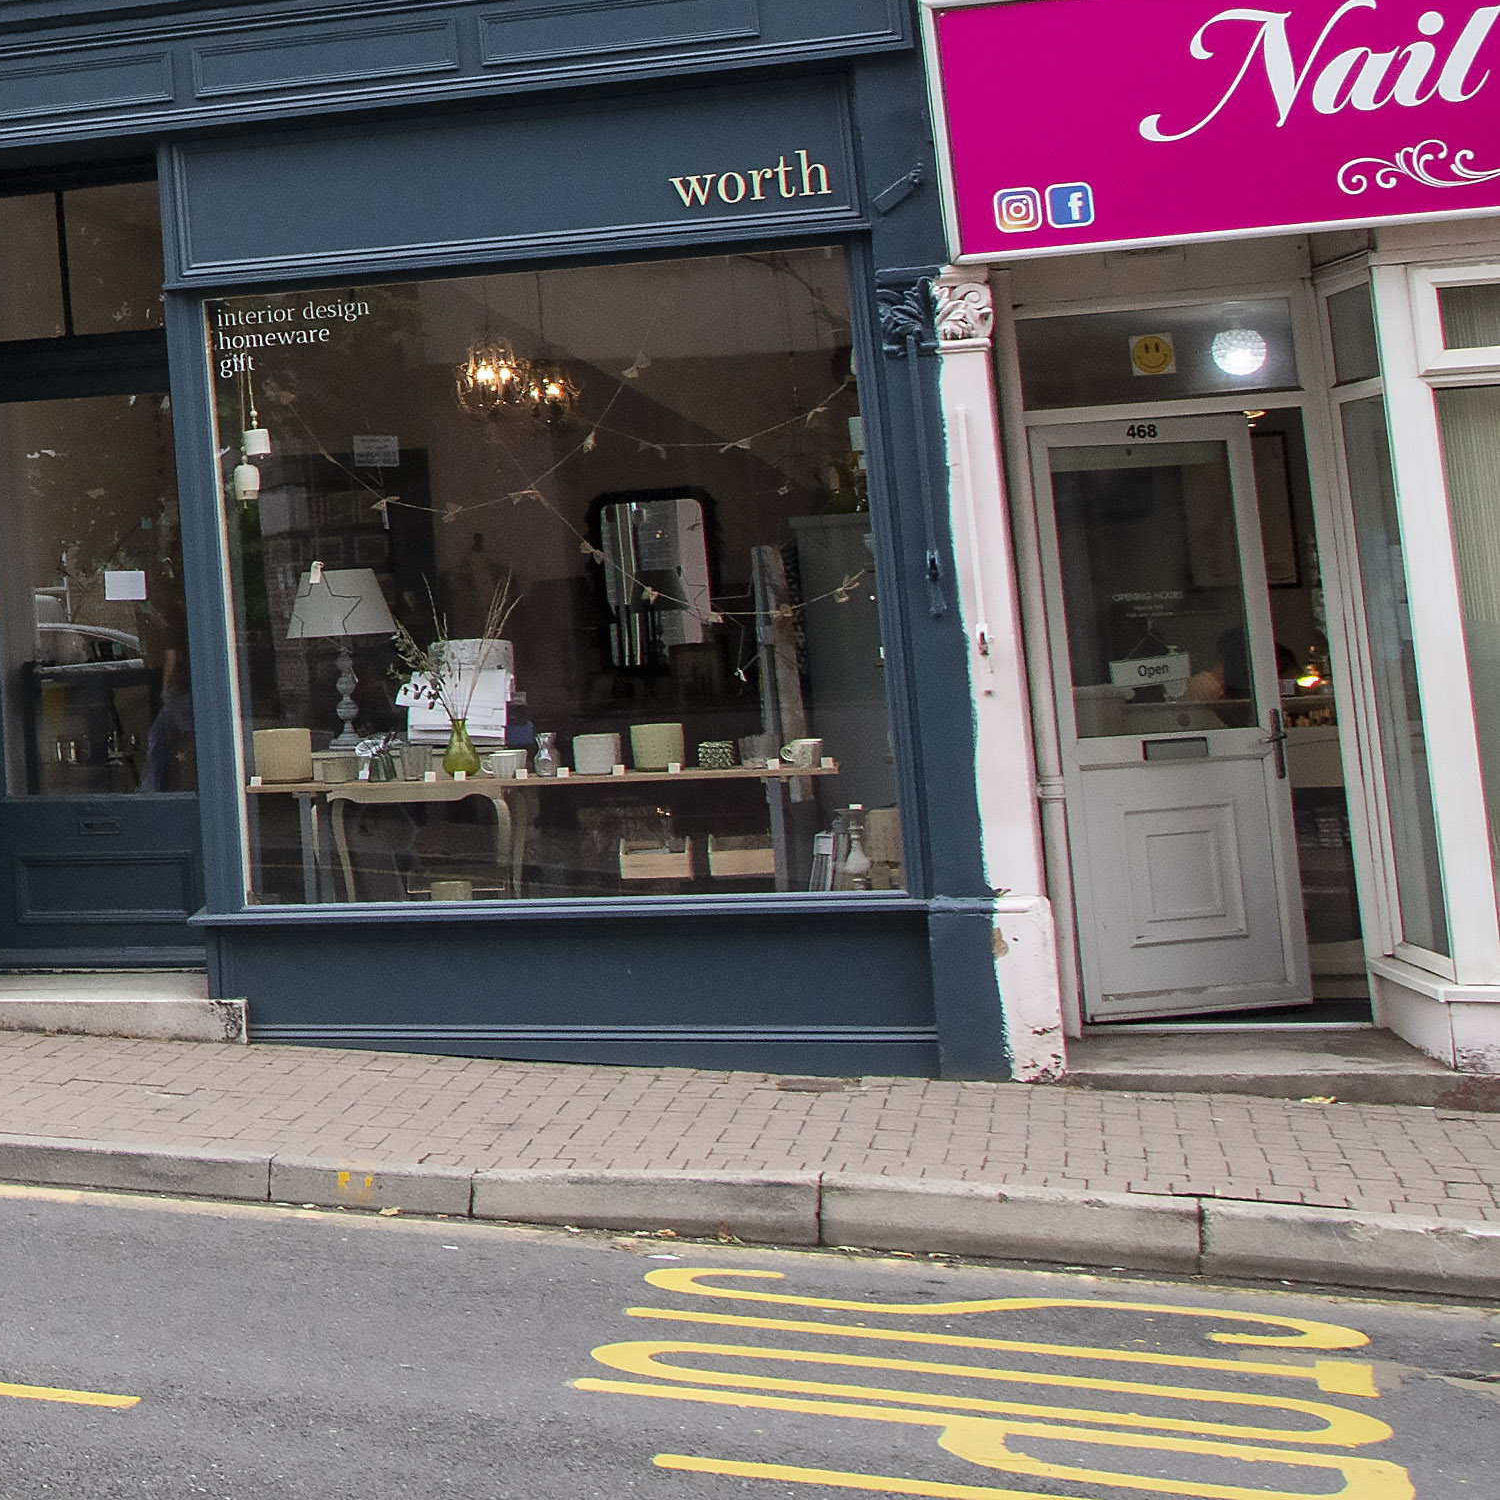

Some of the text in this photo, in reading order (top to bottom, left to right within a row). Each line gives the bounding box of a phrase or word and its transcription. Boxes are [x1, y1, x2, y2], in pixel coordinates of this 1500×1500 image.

[668, 149, 833, 208] worth
[217, 298, 371, 328] interior design
[218, 328, 331, 351] homeware
[219, 352, 256, 378] gift
[1126, 423, 1158, 439] 468
[1137, 663, 1169, 678] Open
